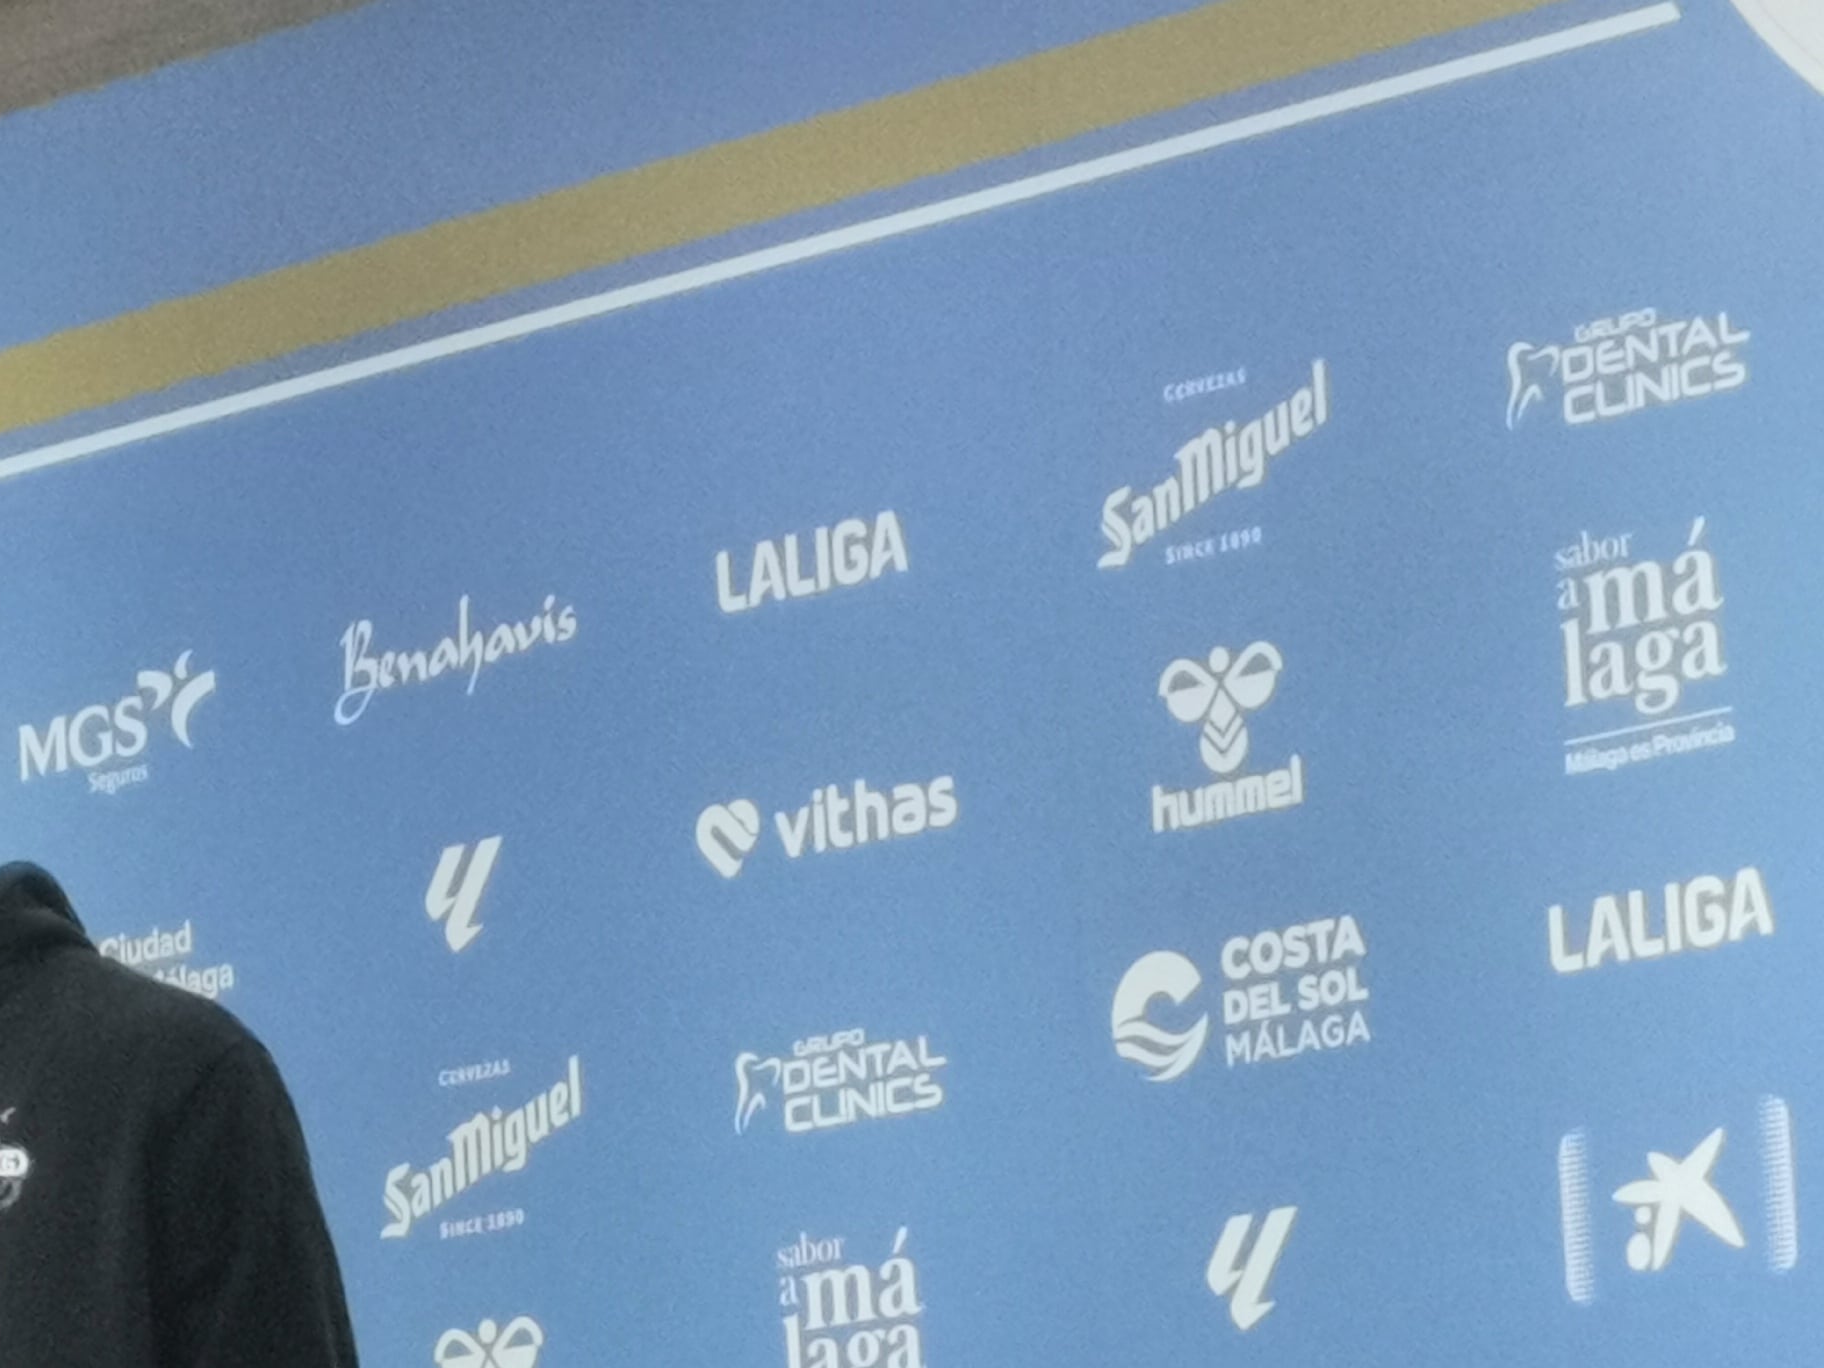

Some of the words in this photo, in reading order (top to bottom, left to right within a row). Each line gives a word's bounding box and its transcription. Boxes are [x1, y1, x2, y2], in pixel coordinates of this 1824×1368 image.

[1562, 311, 1751, 384] DENTAL
[1564, 351, 1745, 424] CLINICS
[716, 509, 908, 614] LALIGA
[1555, 529, 1632, 571] sabor
[18, 695, 148, 783] MGS
[774, 775, 958, 859] vithas
[1151, 753, 1305, 834] hummel
[98, 919, 193, 966] Ciudad
[1221, 914, 1367, 980] COSTA
[1546, 865, 1775, 974] LALIGA
[1223, 981, 1292, 1025] DEL
[1297, 966, 1369, 1011] SOL
[783, 1035, 947, 1095] DENTAL
[1225, 1010, 1371, 1067] MÁLAGA
[785, 1073, 943, 1131] CLINICS
[777, 1231, 846, 1268] sabor
